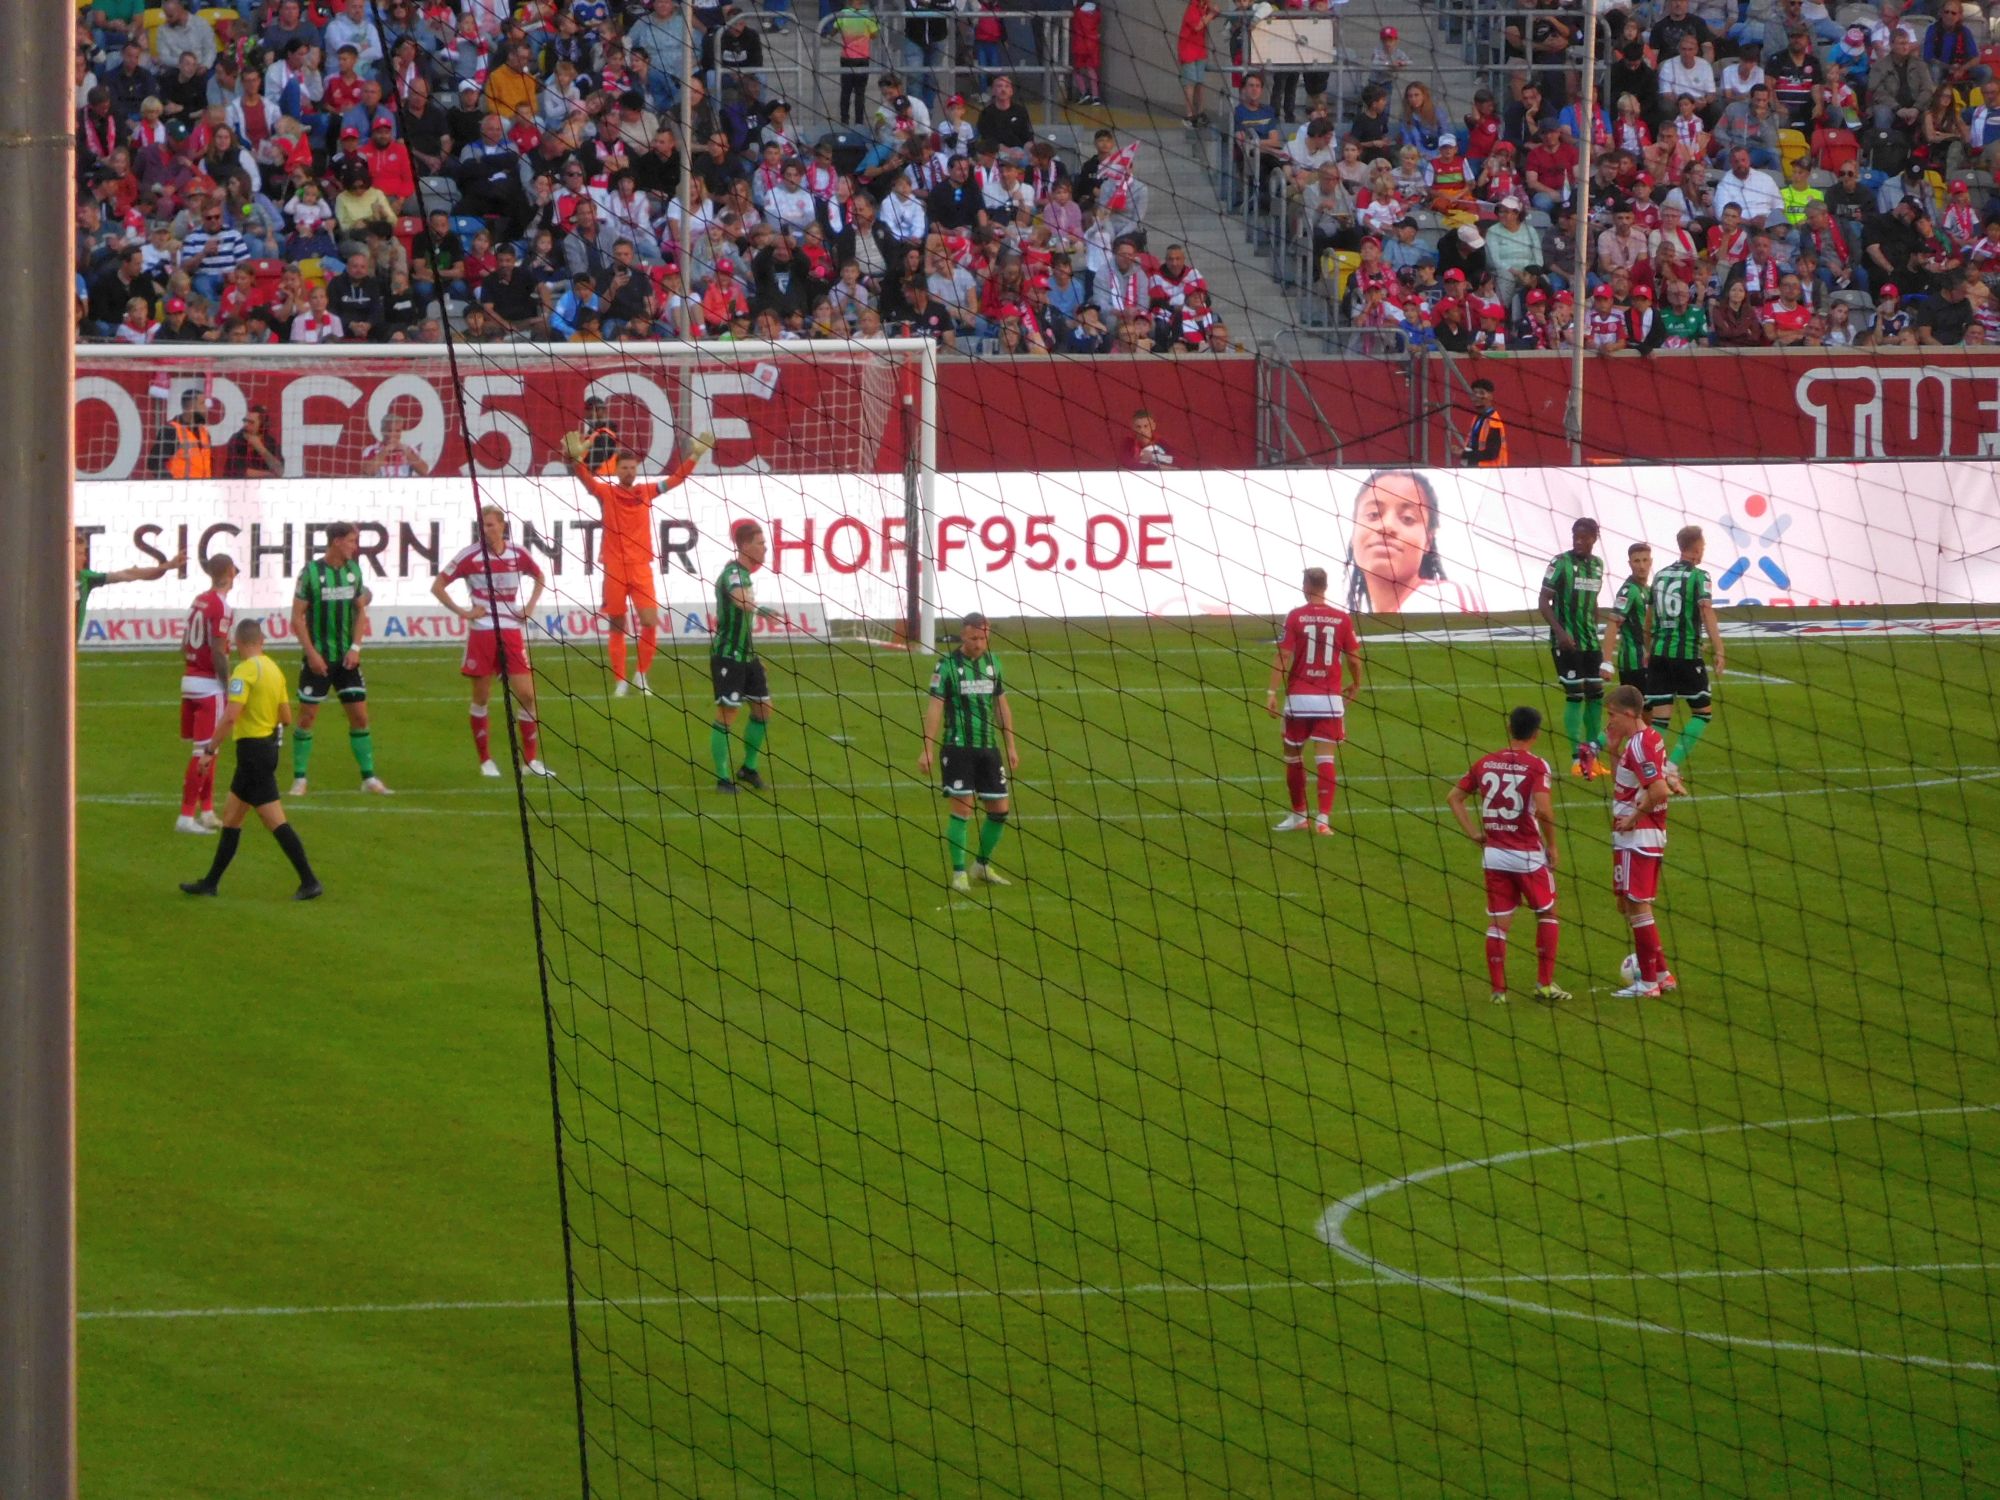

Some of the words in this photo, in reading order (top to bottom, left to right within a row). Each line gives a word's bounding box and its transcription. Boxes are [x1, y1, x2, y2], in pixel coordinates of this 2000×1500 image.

[471, 519, 699, 576] NTR
[730, 514, 1174, 574] HOPF95.DE
[1655, 580, 1682, 618] 16
[1303, 624, 1335, 666] 11
[1481, 771, 1527, 820] 23
[1614, 864, 1623, 883] 8
